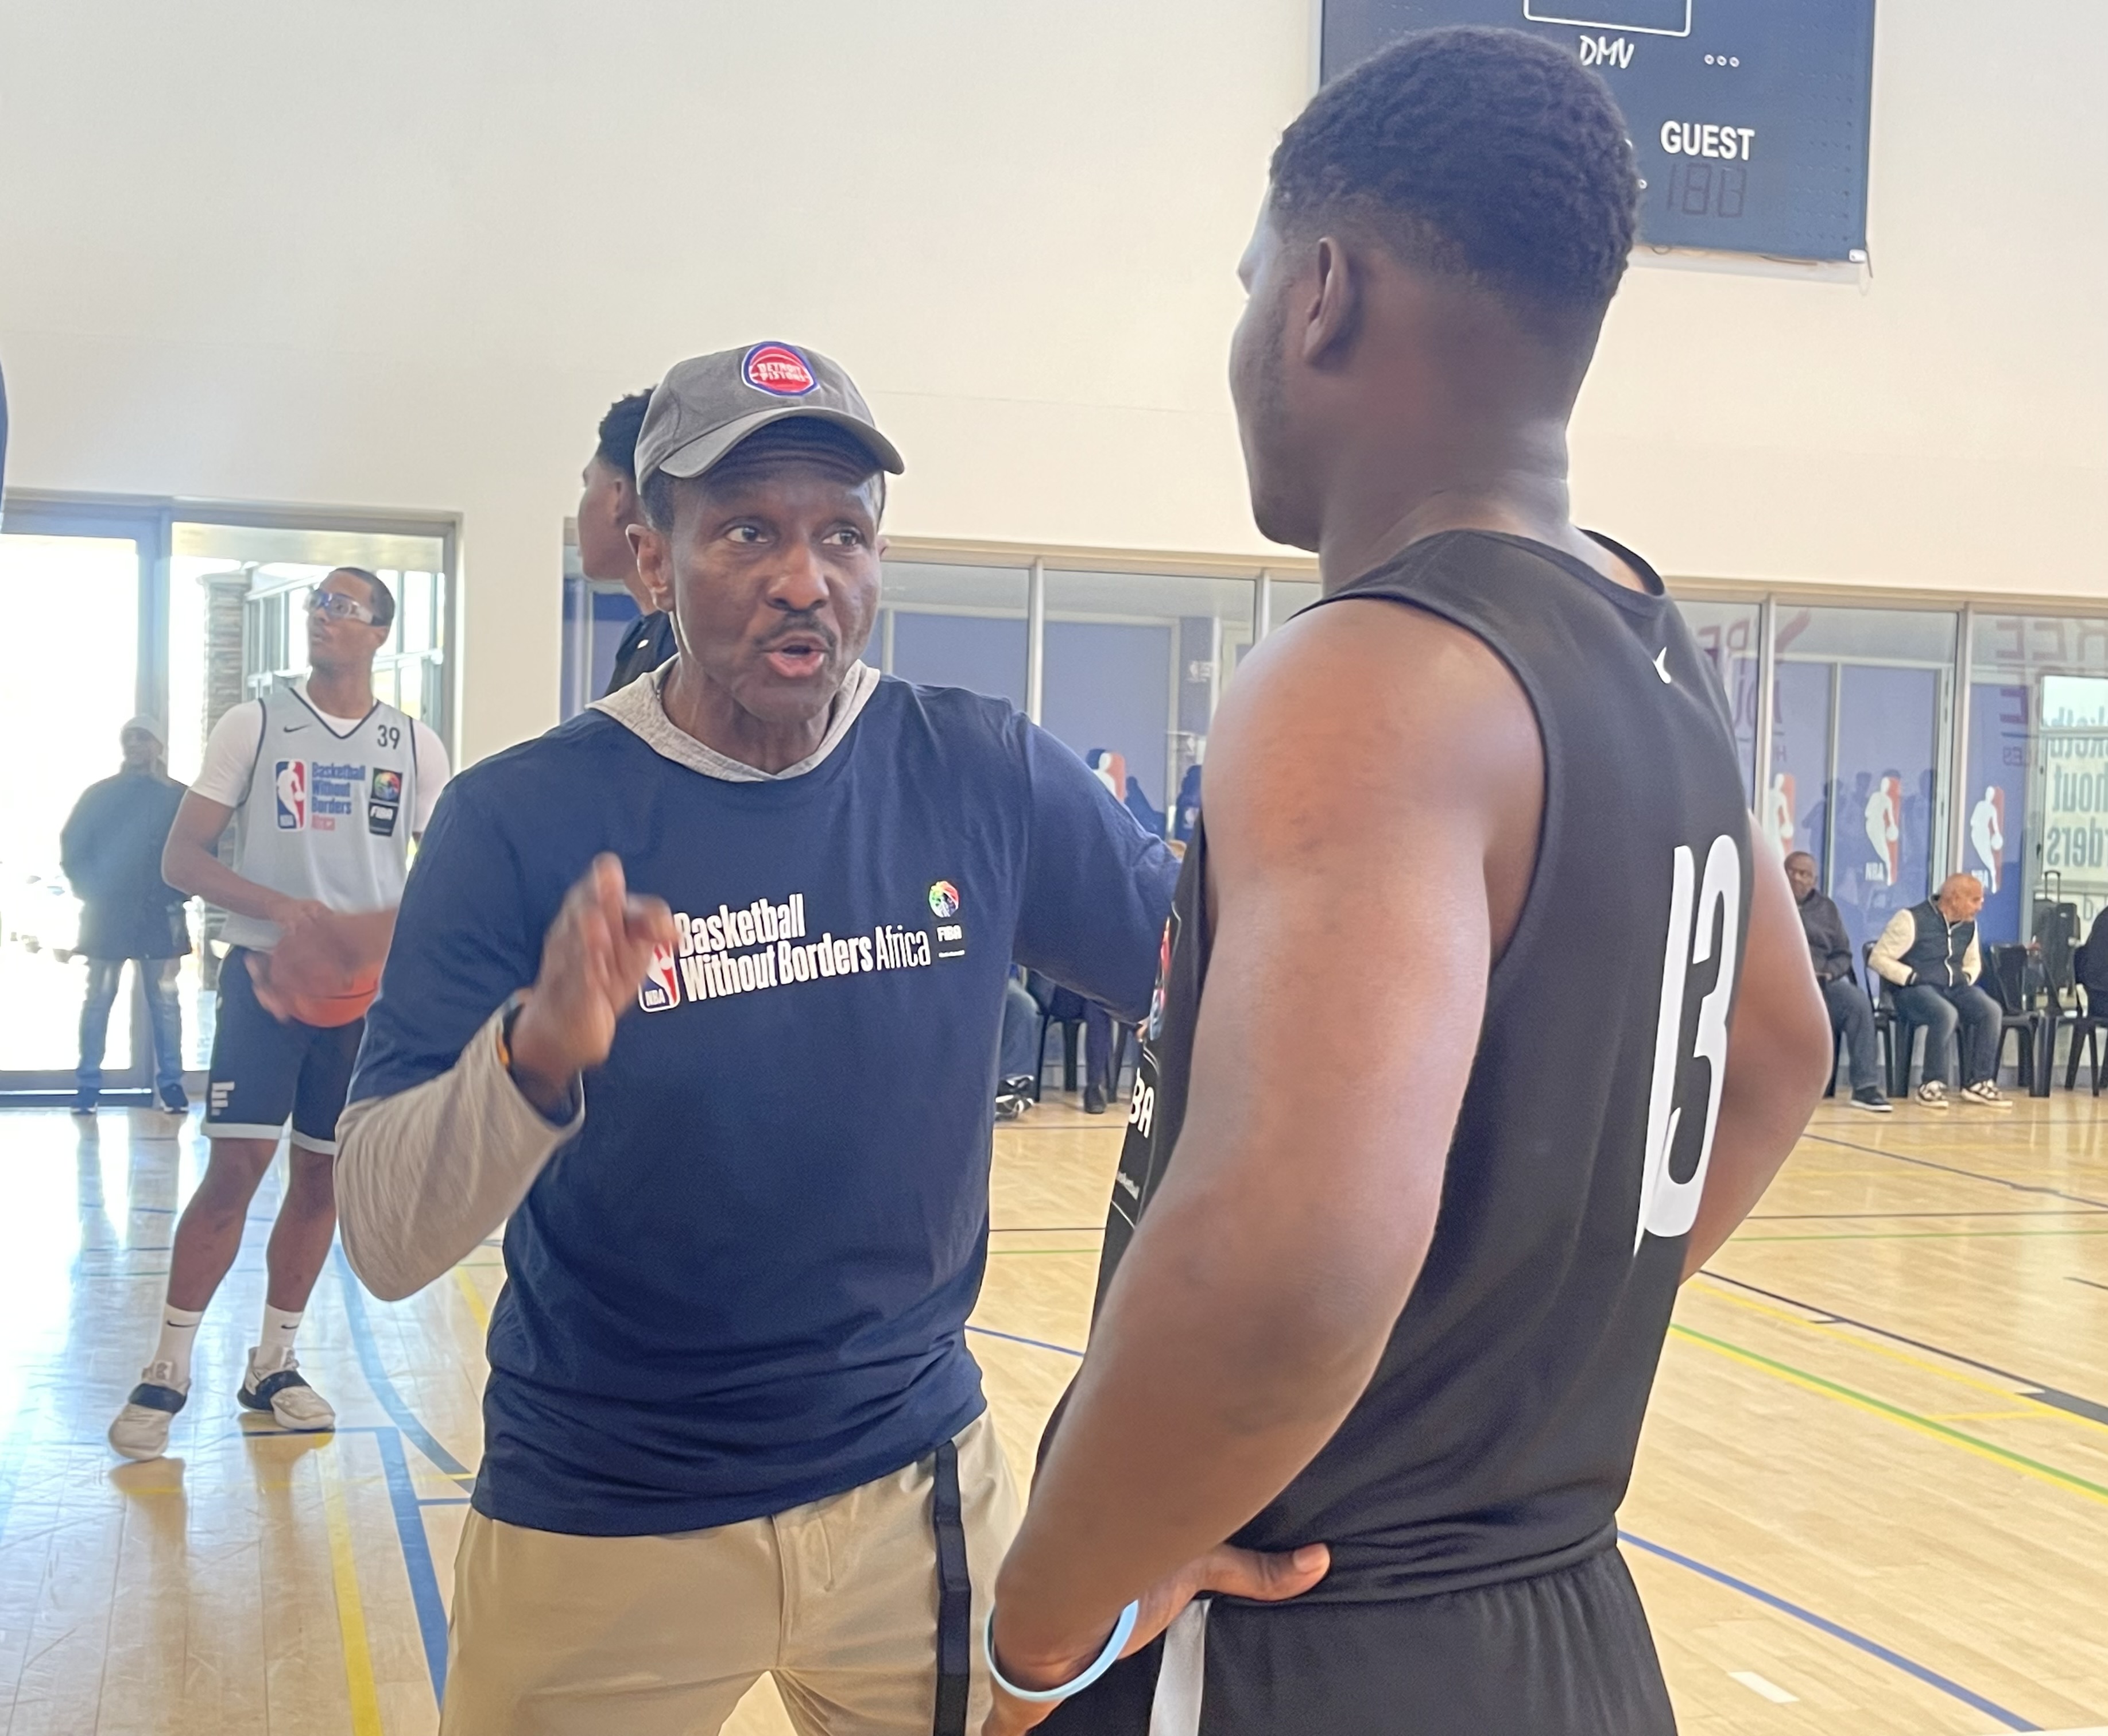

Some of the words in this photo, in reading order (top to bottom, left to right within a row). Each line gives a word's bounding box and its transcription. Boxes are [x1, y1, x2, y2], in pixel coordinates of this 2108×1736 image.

[1660, 121, 1755, 161] GUEST
[757, 362, 803, 376] DETROIT
[377, 724, 401, 750] 39
[1865, 862, 1884, 881] NBA
[674, 893, 805, 958] Basketball
[937, 925, 963, 942] FIBA
[680, 948, 778, 1002] Without
[778, 933, 874, 985] Borders
[875, 925, 931, 970] Africa
[645, 988, 666, 1007] NBA
[1634, 834, 1741, 1257] 13
